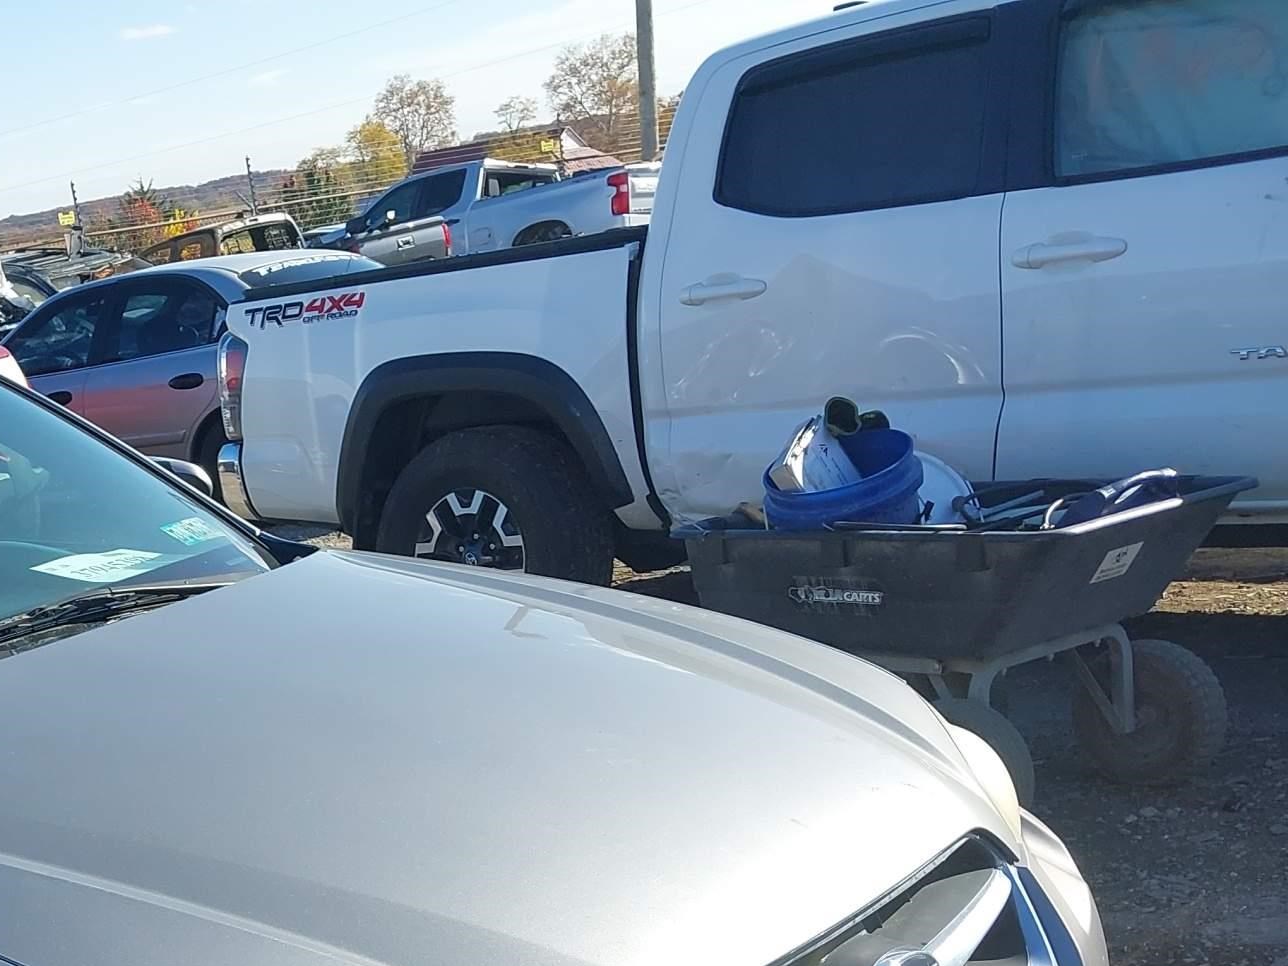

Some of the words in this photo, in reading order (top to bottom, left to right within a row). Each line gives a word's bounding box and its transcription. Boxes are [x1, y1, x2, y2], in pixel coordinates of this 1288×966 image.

[244, 301, 304, 330] TRD
[302, 314, 325, 325] OFF
[326, 309, 359, 321] ROAD
[843, 591, 881, 603] CARTS
